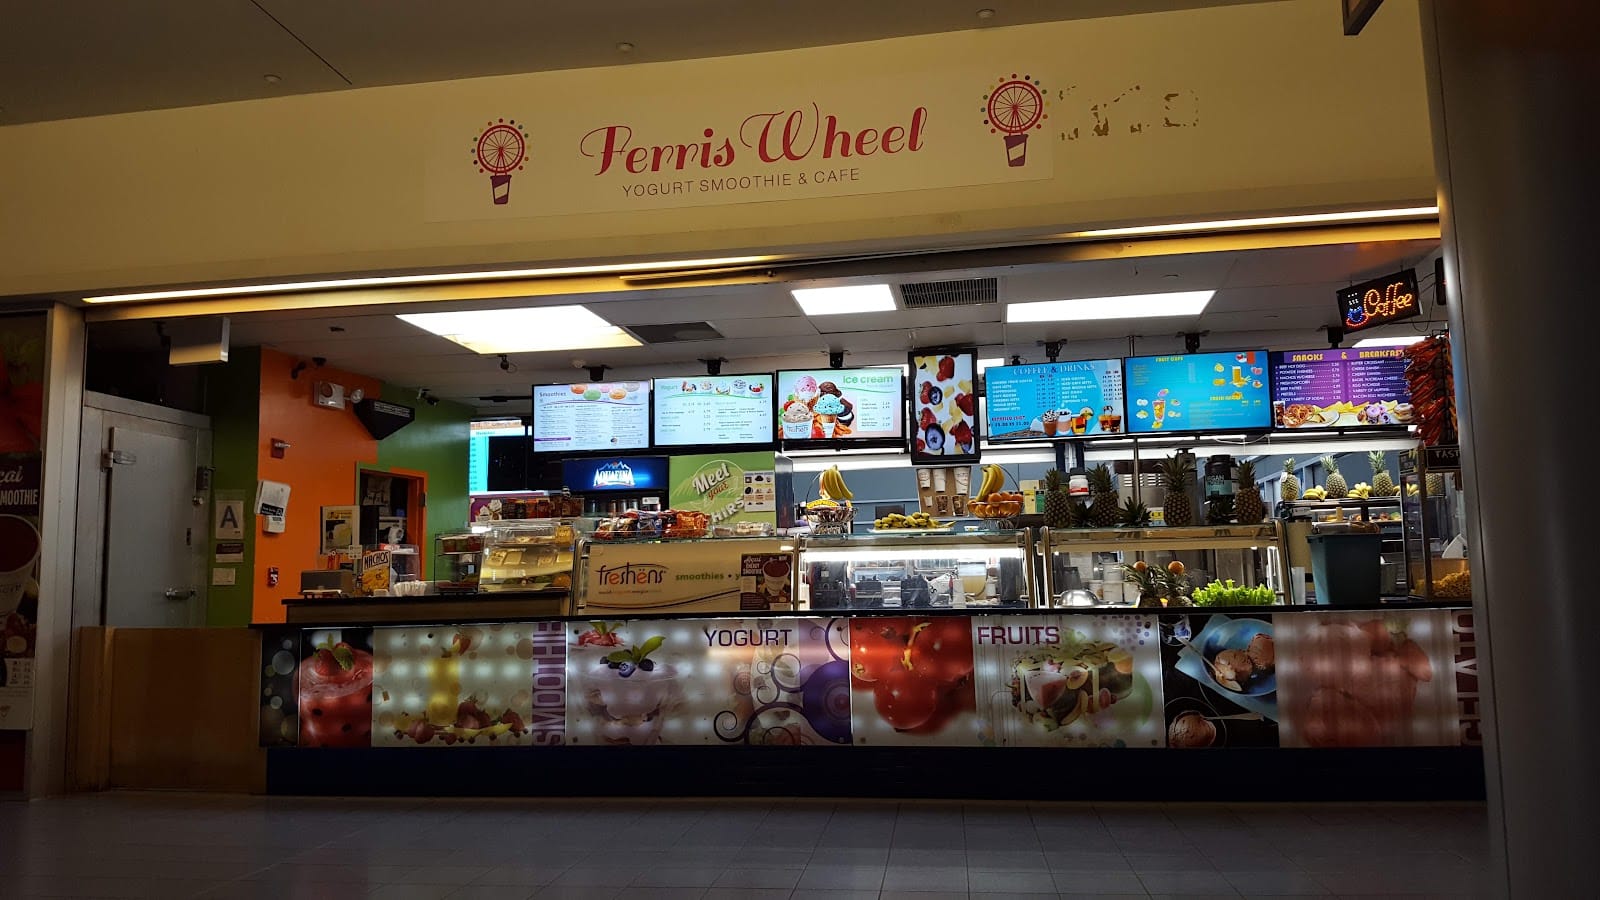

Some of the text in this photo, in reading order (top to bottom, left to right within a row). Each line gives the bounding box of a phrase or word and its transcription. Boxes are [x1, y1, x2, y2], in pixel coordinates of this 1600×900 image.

[580, 102, 928, 177] Ferris Wheel
[622, 168, 861, 198] YOGURT SMOOTHIE & CAFE
[1364, 282, 1413, 317] Coffee
[1292, 353, 1323, 362] SNACKS
[1341, 352, 1348, 360] &
[1013, 363, 1096, 375] COFFEE & DRINKS
[843, 374, 894, 385] ice cream
[593, 468, 635, 487] AQUAFINA
[692, 463, 731, 495] Meet
[0, 489, 39, 506] MOOTHIE
[219, 505, 238, 528] A
[710, 496, 745, 523] HIRS
[363, 551, 389, 569] NACHOS
[675, 573, 724, 581] smoothies
[704, 629, 792, 647] YOGURT
[978, 626, 1060, 645] FRUITS
[532, 621, 566, 745] SMOOTHIE
